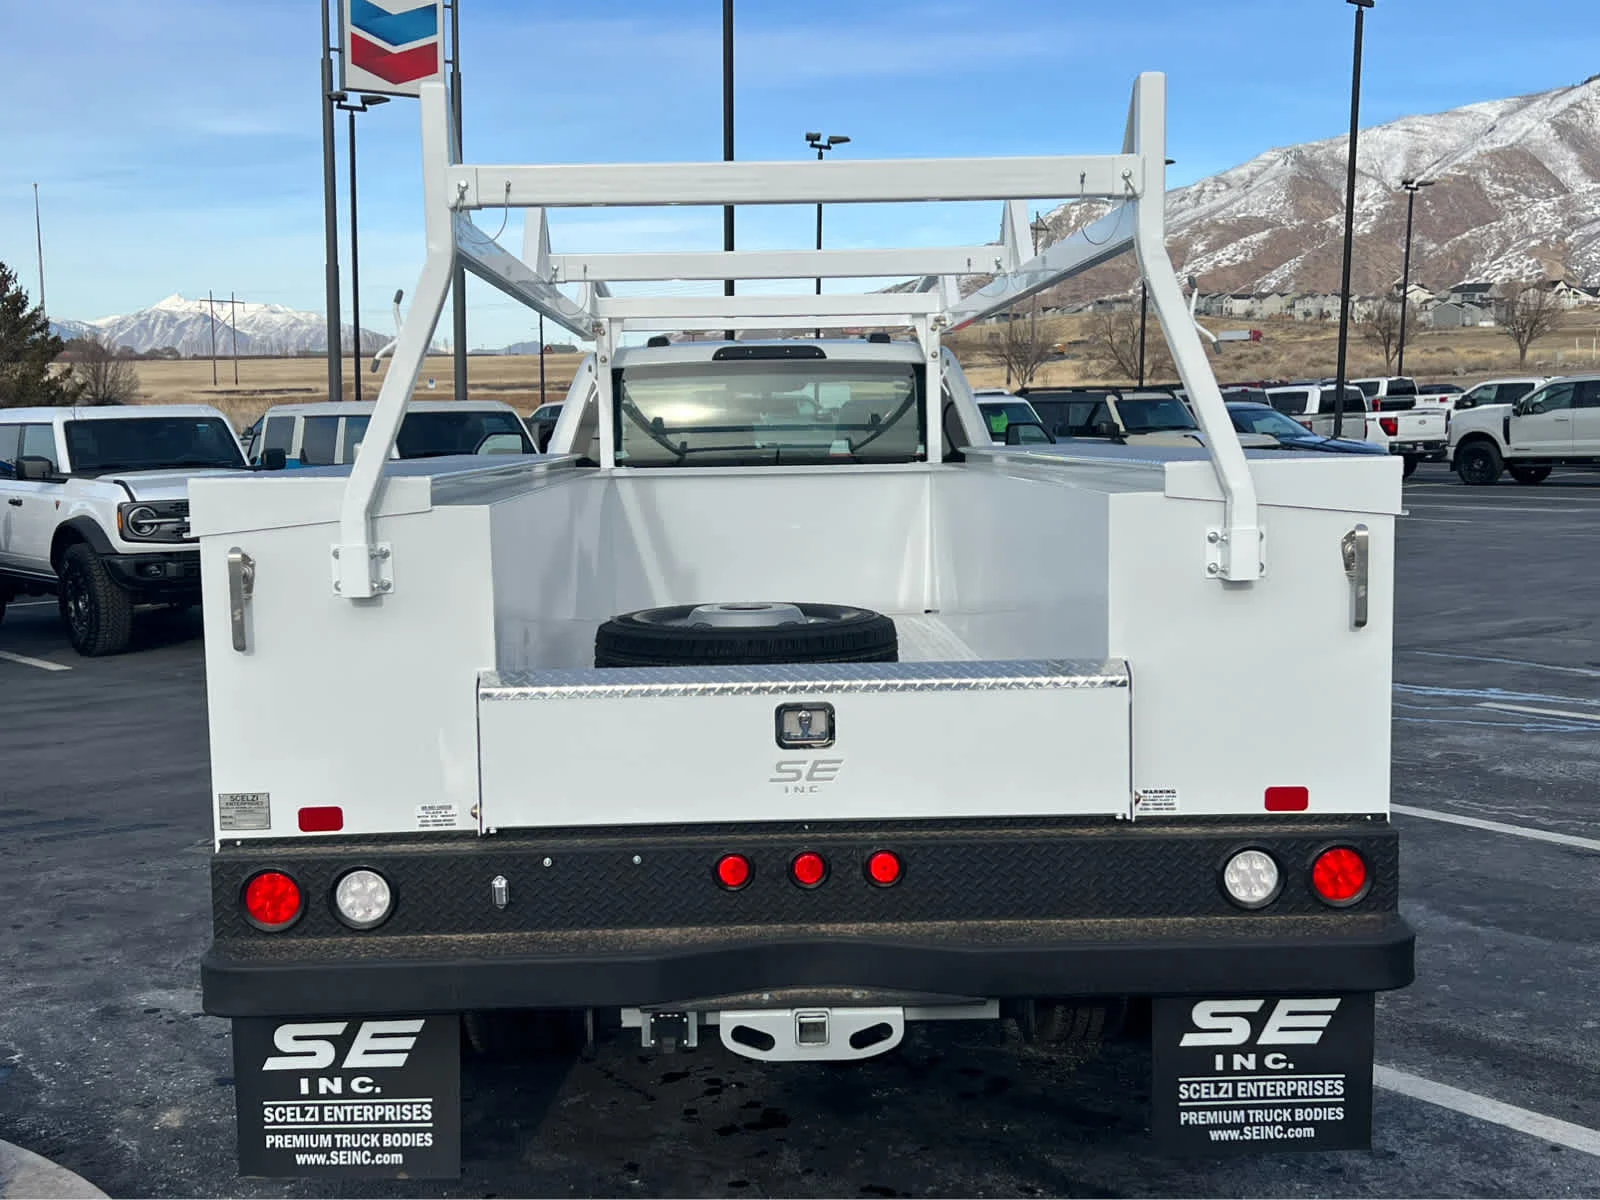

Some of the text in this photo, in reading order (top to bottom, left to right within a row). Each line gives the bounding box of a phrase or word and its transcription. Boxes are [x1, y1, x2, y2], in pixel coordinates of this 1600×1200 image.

[769, 759, 844, 782] SE
[1179, 998, 1342, 1047] SE
[262, 1019, 425, 1071] SE
[1215, 1053, 1295, 1071] INC.
[300, 1076, 382, 1095] INC.
[1178, 1080, 1345, 1100] SCELZI ENTERPRISES
[263, 1104, 433, 1123] SCELZI ENTERPRISES
[1180, 1107, 1345, 1126] PREMIUM TRUCK BODIES
[265, 1132, 433, 1149] PREMIUM TRUCK BODIES
[1209, 1125, 1315, 1142] www.SEINC.com
[295, 1150, 403, 1166] www.SEINC.com
